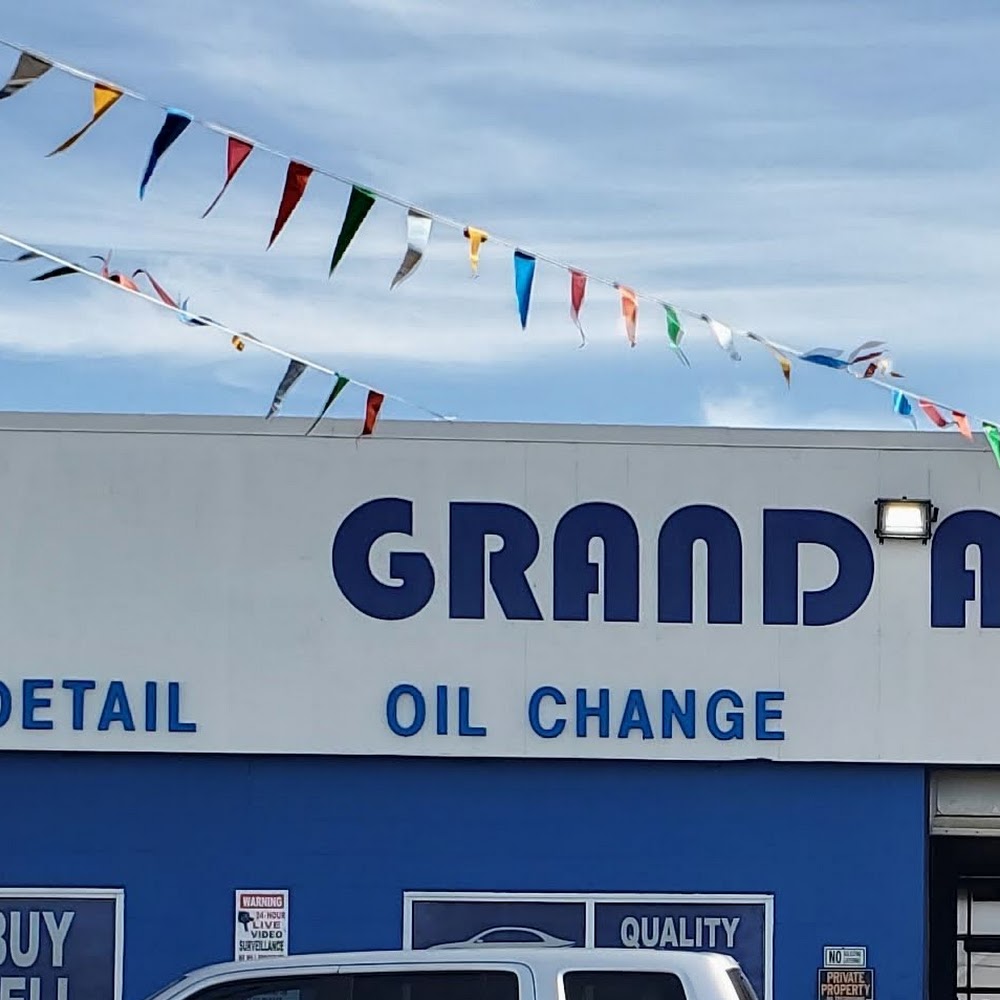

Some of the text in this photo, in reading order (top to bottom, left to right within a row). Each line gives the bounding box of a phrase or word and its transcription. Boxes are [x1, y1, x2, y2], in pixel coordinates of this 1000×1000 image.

[331, 497, 875, 627] GRAND
[385, 684, 786, 742] OIL CHANGE
[242, 895, 283, 908] WARNING
[252, 920, 282, 929] LIVE
[251, 930, 283, 939] VIDEO
[620, 916, 741, 949] QUALITY
[0, 911, 75, 968] UY
[829, 950, 842, 963] NO
[826, 971, 866, 984] PRIVATE
[821, 983, 871, 997] PROPERTY
